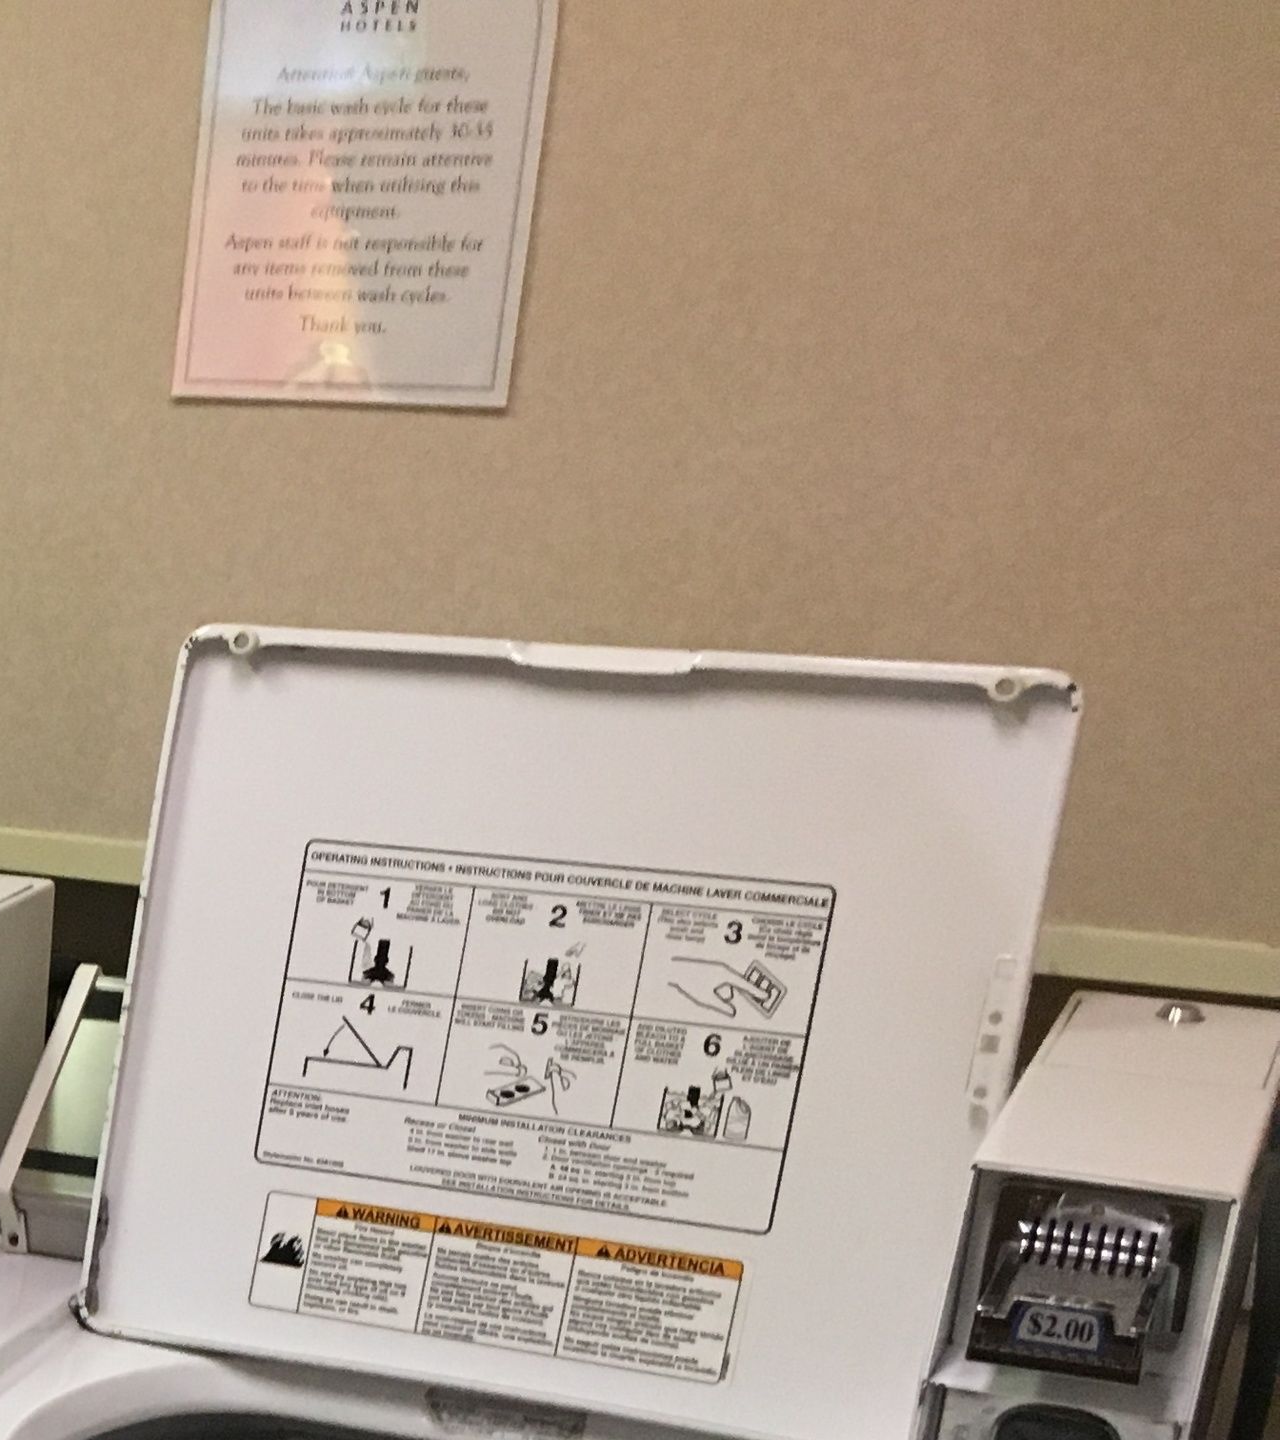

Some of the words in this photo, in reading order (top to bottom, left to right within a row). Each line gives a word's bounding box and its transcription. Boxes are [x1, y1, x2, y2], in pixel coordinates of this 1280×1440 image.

[341, 0, 419, 15] ASPEN
[340, 20, 417, 33] HOTELS
[251, 97, 281, 116] The
[287, 96, 324, 114] basic
[330, 96, 370, 116] wash
[373, 96, 411, 115] cycle
[417, 95, 440, 113] for
[446, 94, 488, 113] these
[241, 127, 279, 141] units
[284, 123, 324, 141] takes
[328, 120, 442, 145] approximately
[308, 148, 356, 167] Please
[359, 152, 416, 167] remain
[422, 152, 492, 167] attentive
[241, 179, 257, 192] to
[262, 176, 287, 192] the
[331, 177, 374, 192] when
[450, 175, 481, 193] this
[224, 233, 273, 253] Aspen
[279, 232, 312, 250] staff
[364, 231, 455, 254] responsible
[460, 232, 484, 251] for
[265, 261, 305, 276] items
[311, 257, 379, 277] removed
[383, 261, 423, 277] from
[428, 259, 470, 278] these
[244, 285, 283, 301] units
[288, 282, 353, 302] between
[357, 284, 397, 302] wash
[298, 314, 349, 333] Thank
[310, 850, 368, 866] OPERATING
[369, 856, 447, 873] INSTRUCTIONS
[454, 863, 533, 881] INSTRUCTIONS
[532, 871, 566, 884] POUR
[565, 874, 633, 890] COUVERCLE
[633, 880, 650, 892] DE
[651, 881, 704, 897] MACHINE
[705, 886, 742, 900] LAVER
[742, 890, 830, 908] COMMERCIALE
[377, 885, 391, 909] 1
[549, 903, 568, 928] 2
[723, 919, 744, 945] 3
[359, 992, 377, 1015] 4
[531, 1012, 549, 1036] 5
[702, 1032, 722, 1057] 6
[350, 1206, 421, 1229] WARNING
[452, 1222, 574, 1252] AVERTISSEMENT
[613, 1246, 727, 1276] ADVERTENCIA
[1026, 1312, 1094, 1343] $2.00
